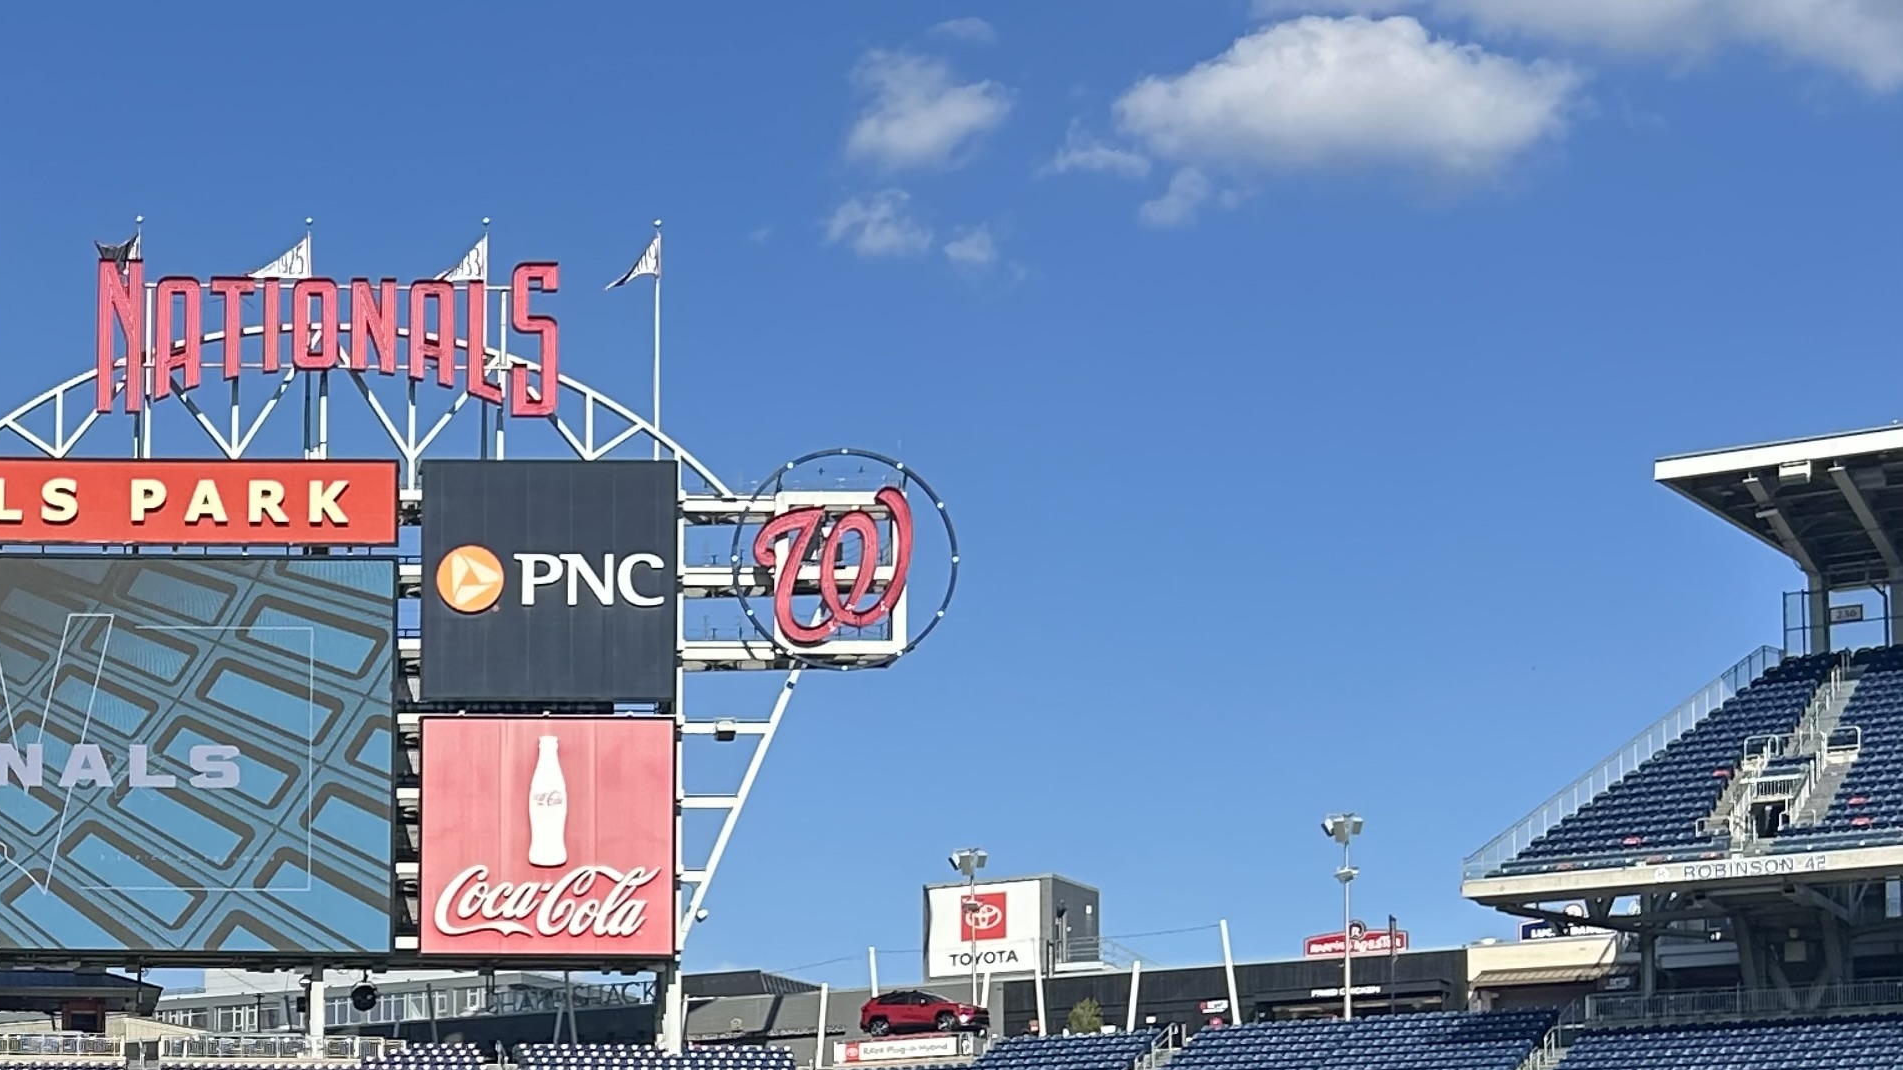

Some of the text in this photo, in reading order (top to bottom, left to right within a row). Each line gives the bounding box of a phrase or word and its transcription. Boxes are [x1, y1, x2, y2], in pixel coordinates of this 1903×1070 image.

[97, 258, 558, 417] NATIONALS
[130, 480, 350, 525] PARK
[514, 553, 665, 607] PNC
[1684, 855, 1826, 879] ROBINSON 42
[435, 864, 660, 939] Coca-Cola
[949, 950, 1018, 966] TOYOTA
[574, 981, 657, 1008] SHACK
